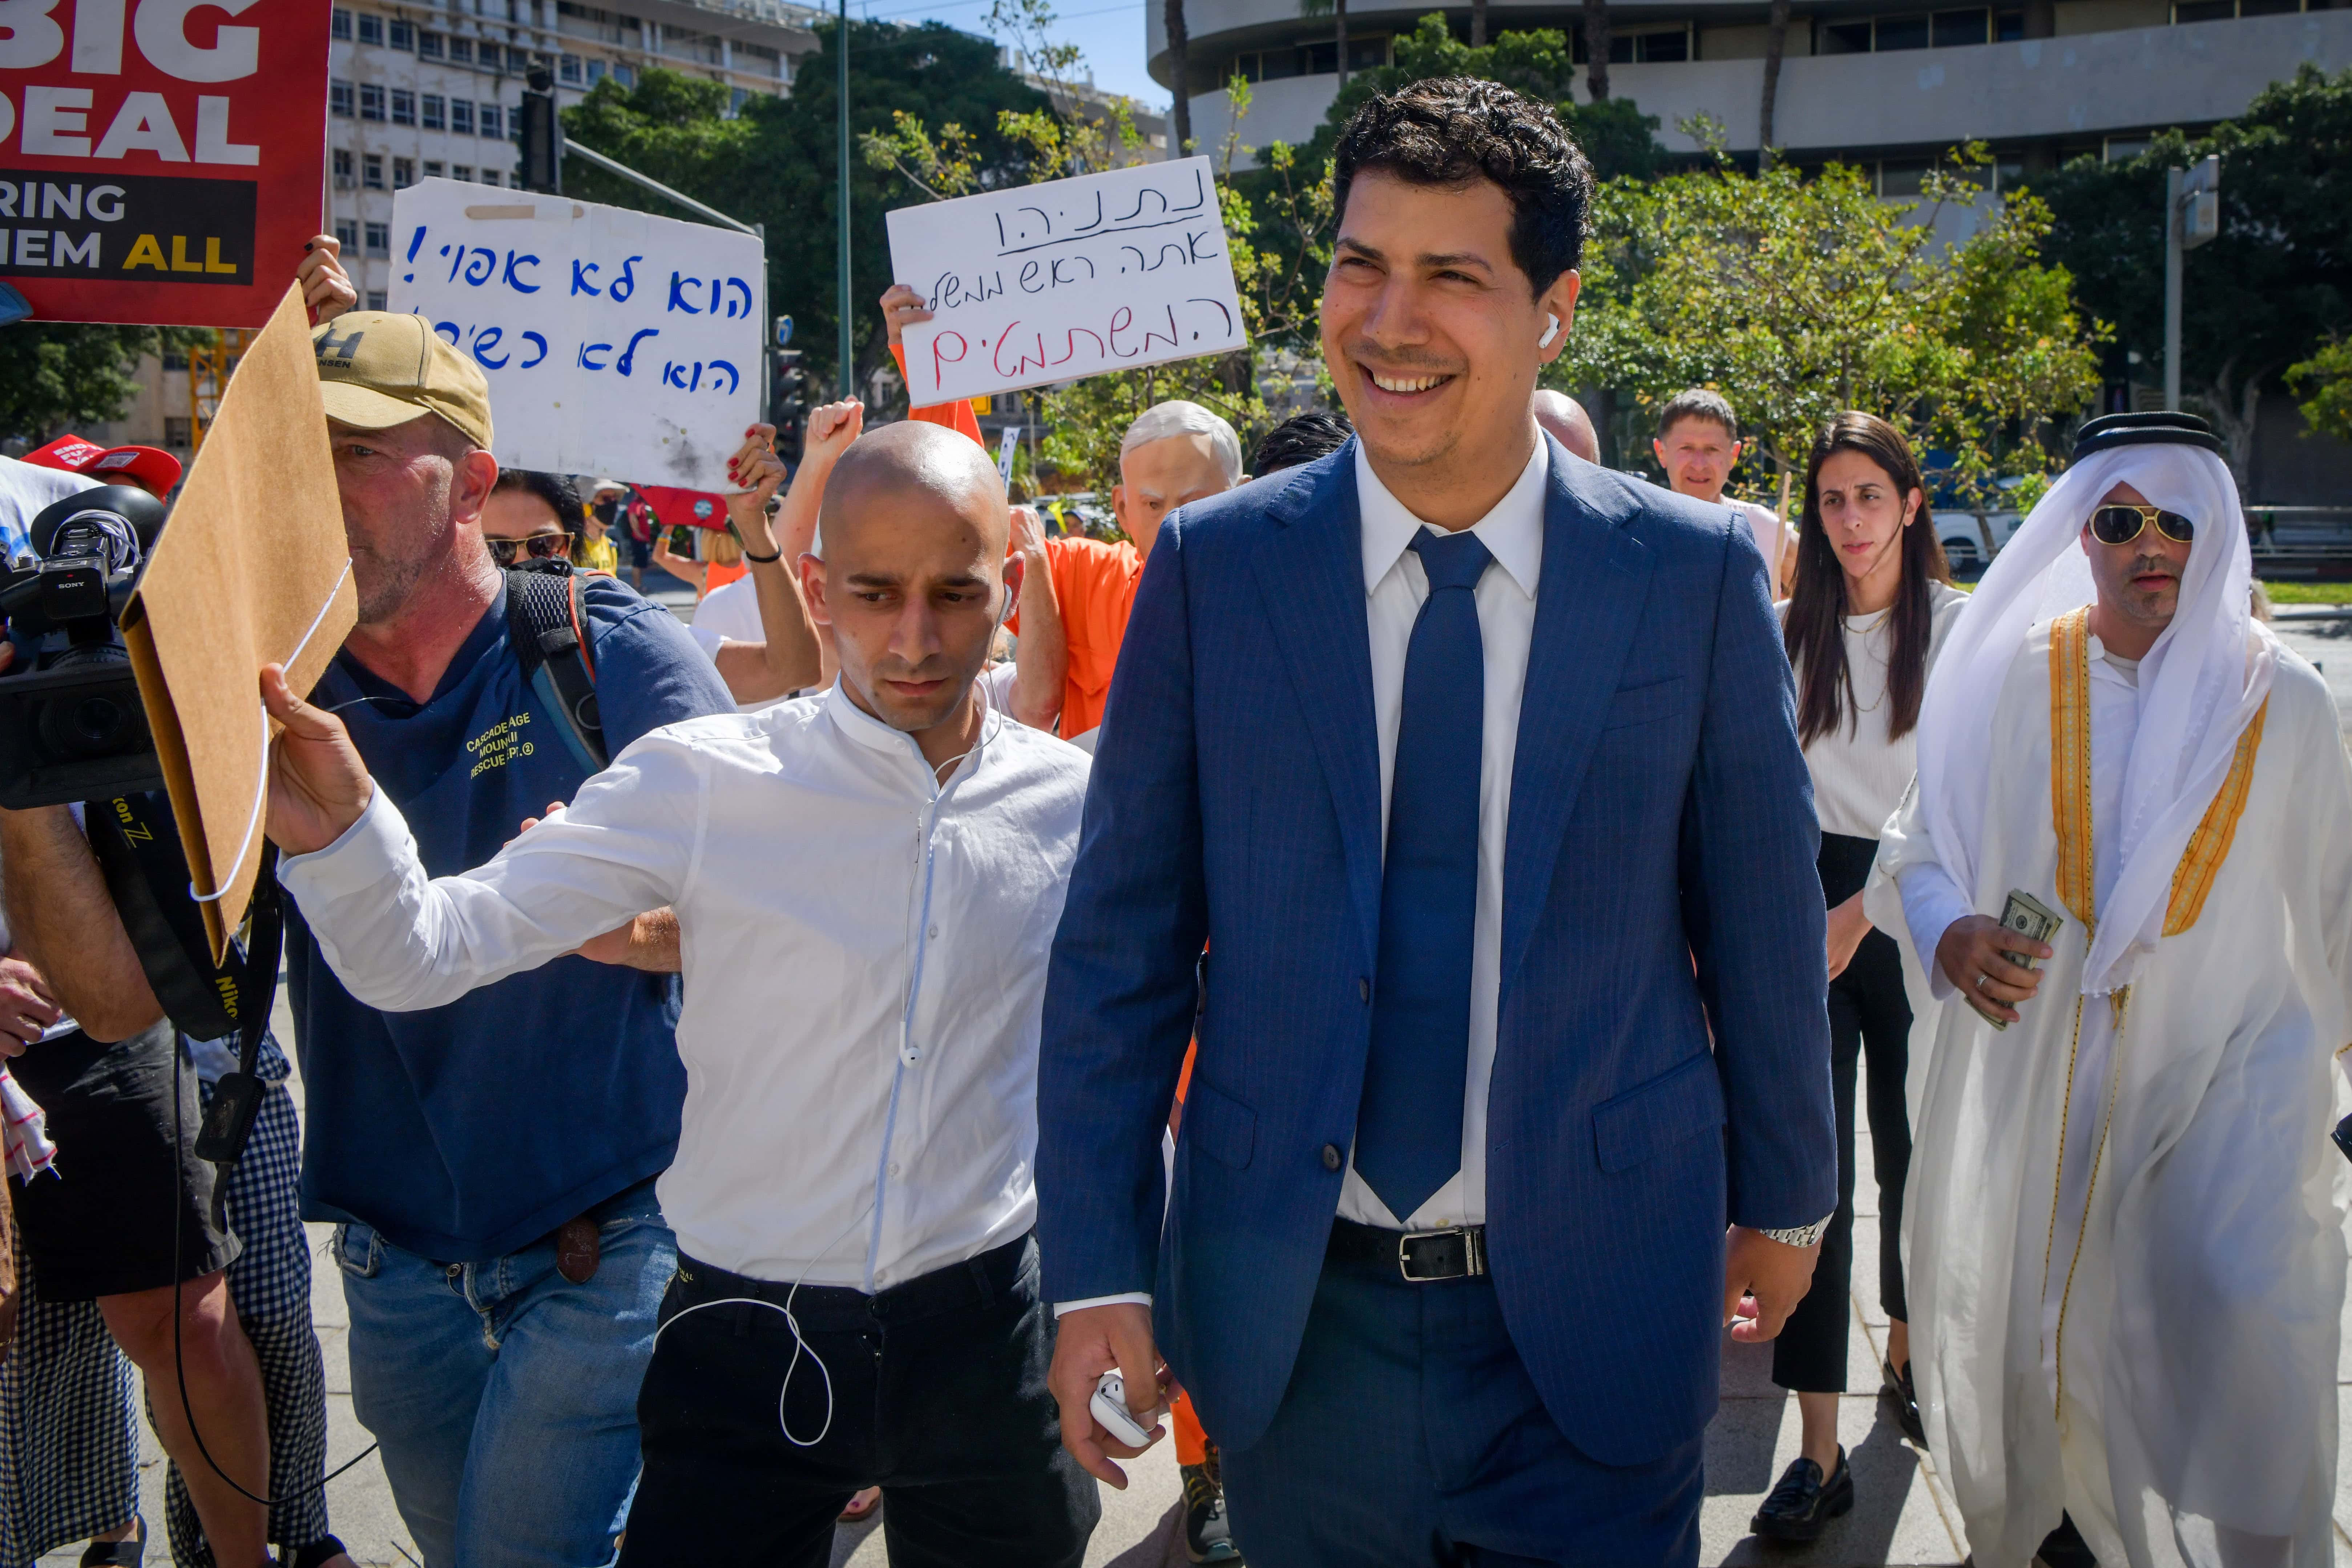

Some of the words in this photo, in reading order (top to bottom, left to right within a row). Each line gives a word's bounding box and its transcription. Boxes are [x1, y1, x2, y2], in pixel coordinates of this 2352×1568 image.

[0, 85, 260, 166] EAL
[996, 169, 1203, 247] נתניהו
[0, 229, 101, 268] EM
[122, 234, 237, 273] ALL
[1121, 231, 1218, 274] אתה
[571, 256, 643, 302] לא
[667, 271, 752, 319] הוא
[911, 271, 1002, 311] ממשל
[1020, 257, 1094, 293] ראש
[577, 328, 659, 377] לא
[933, 298, 1231, 391] המשתמטים
[662, 360, 739, 395] הוא
[466, 722, 508, 752] CASCADE
[509, 712, 530, 727] AGE
[471, 754, 505, 779] RESCUE
